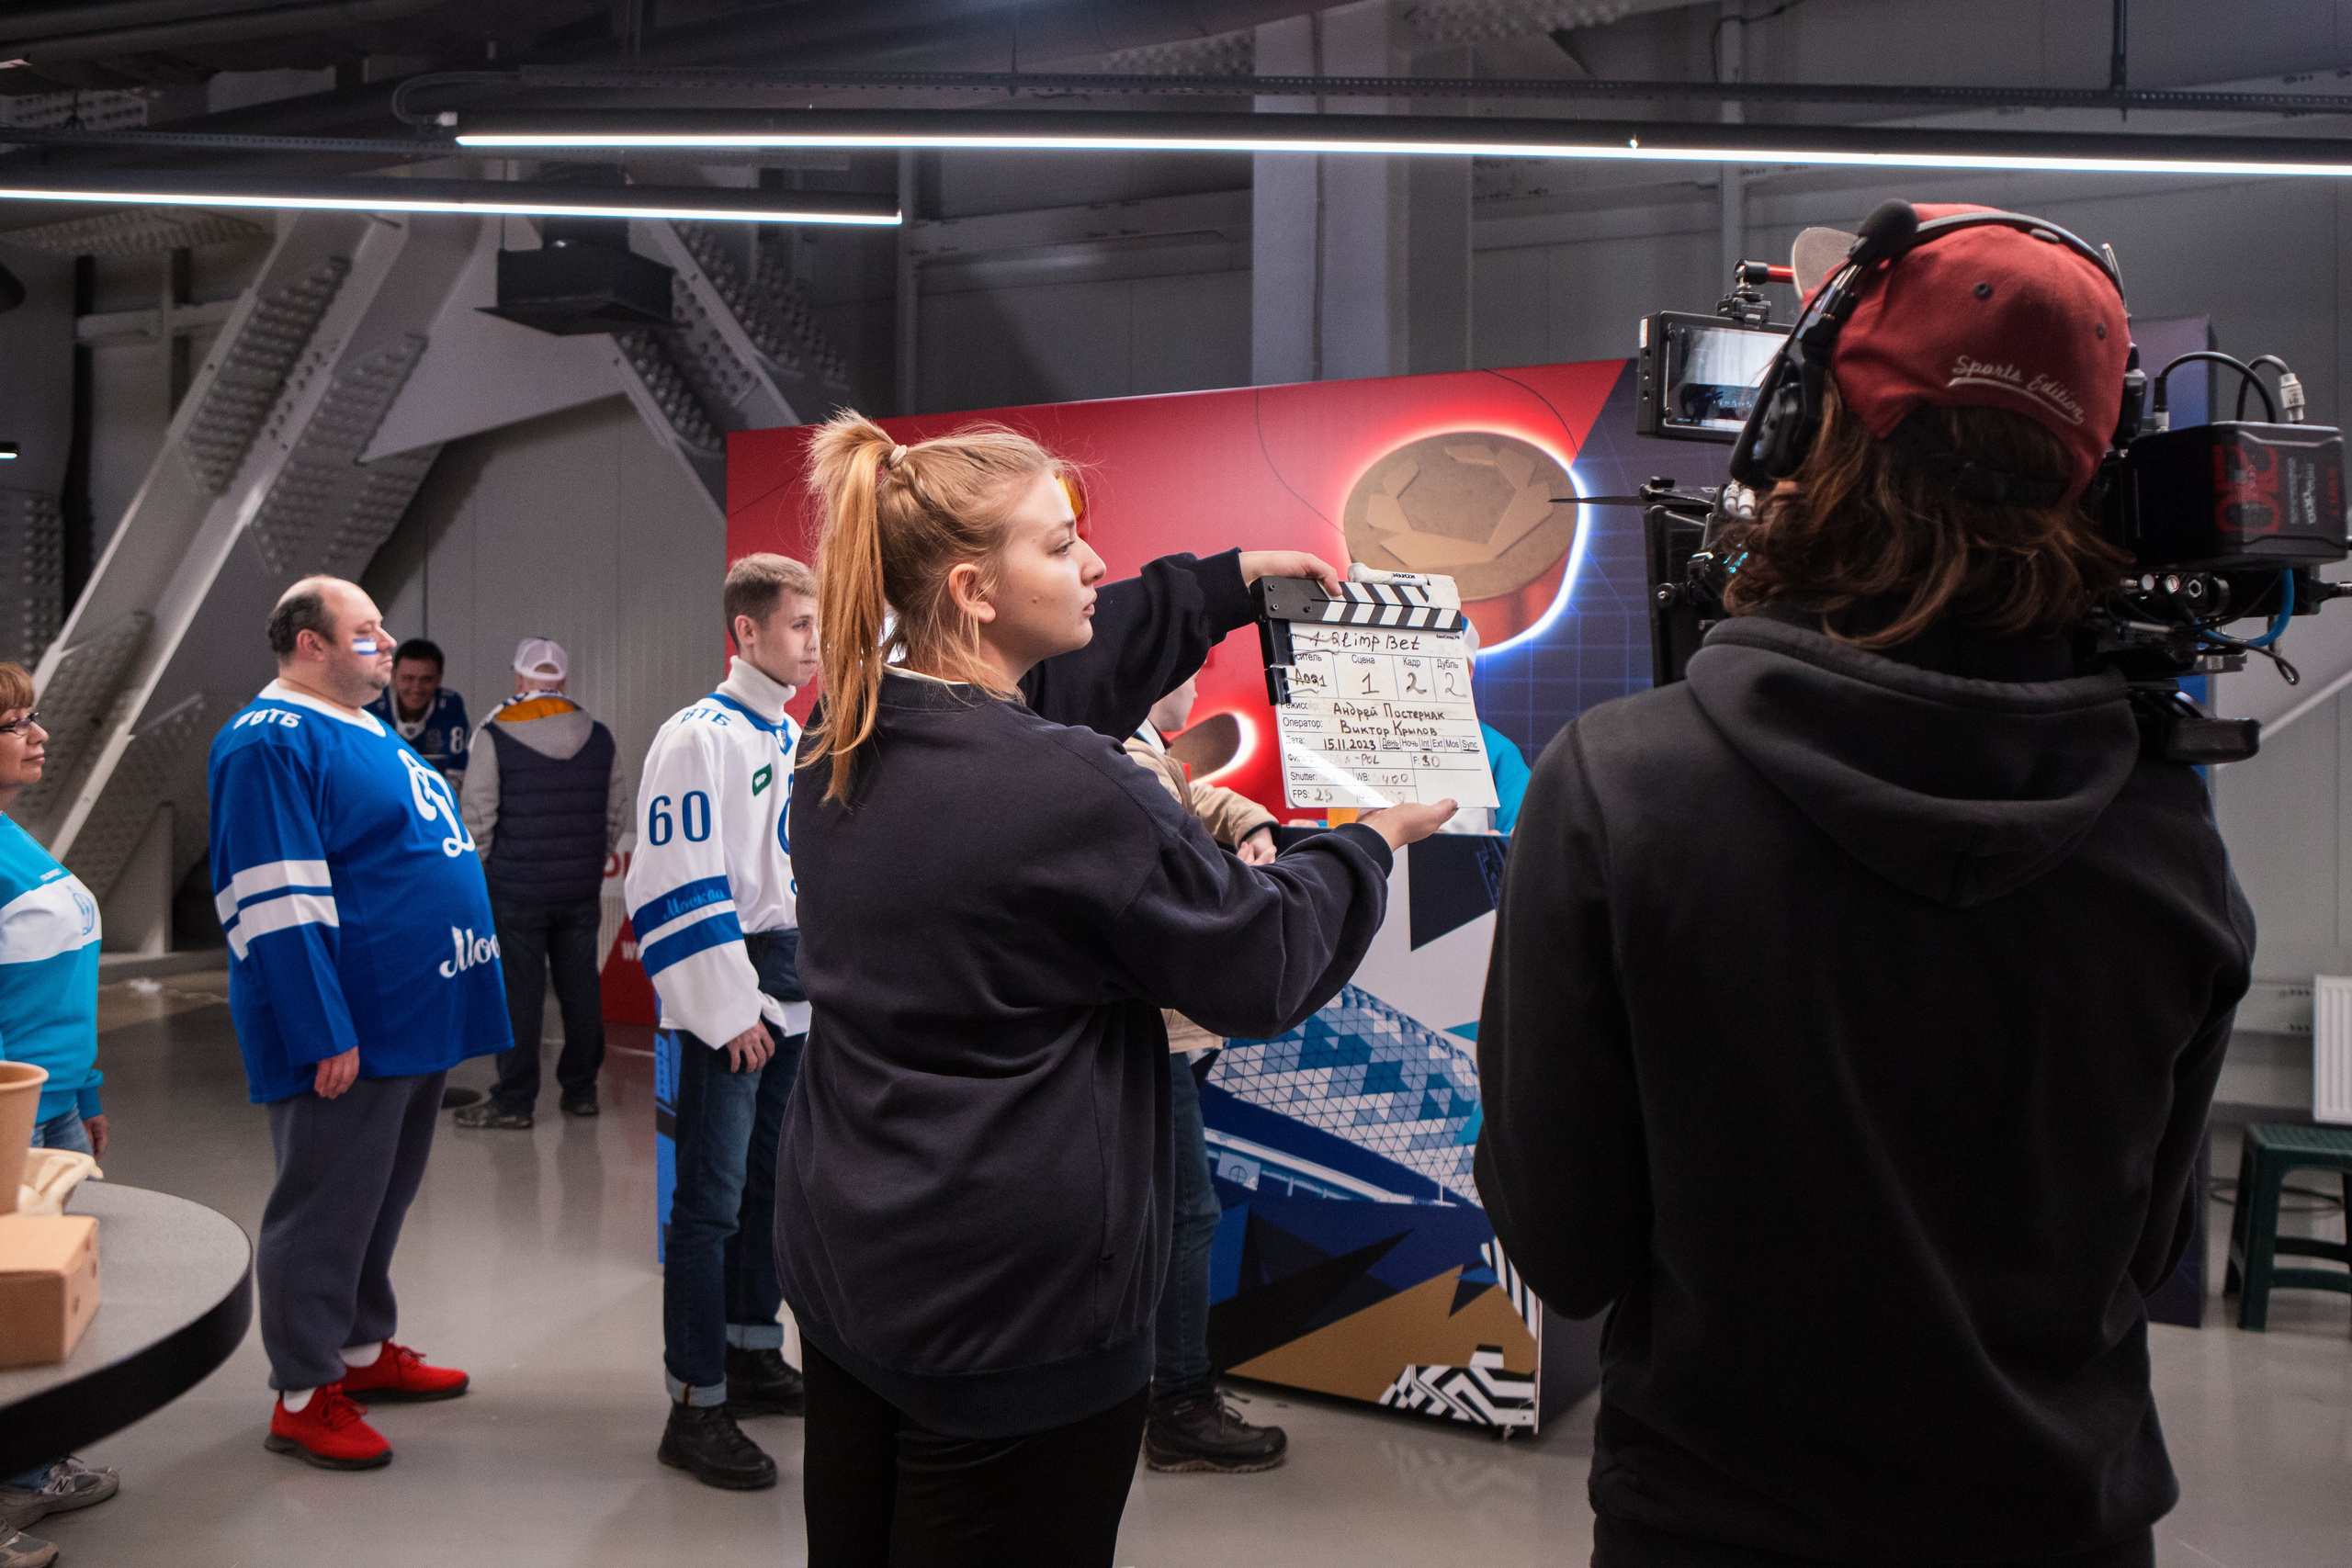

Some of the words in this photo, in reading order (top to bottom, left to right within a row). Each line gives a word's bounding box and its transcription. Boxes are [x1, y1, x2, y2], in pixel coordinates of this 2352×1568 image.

[1951, 355, 2022, 381] Sports
[2027, 372, 2085, 416] Edition
[1385, 634, 1421, 650] Bet
[1351, 654, 1376, 665] Сцена
[1402, 657, 1422, 669] Кадр
[1436, 659, 1459, 671] Дубль
[1362, 671, 1380, 695] 1
[1406, 671, 1428, 695] 2
[1444, 671, 1468, 698] 2
[681, 707, 732, 727] ВТБ
[1333, 702, 1379, 722] Андрей
[1383, 703, 1446, 722] Постернак
[1283, 716, 1324, 730] Оператор:
[1340, 718, 1390, 738] Виктор
[1392, 719, 1439, 738] Крылов
[1323, 738, 1377, 751] 15.11.2023
[1382, 738, 1399, 749] День
[1402, 738, 1419, 749] Ночь
[1420, 739, 1430, 748] Int
[1432, 739, 1443, 749] Ext
[1445, 739, 1460, 749] Mos
[1462, 739, 1478, 750] Sync
[1413, 756, 1420, 765] F:
[1290, 772, 1317, 782] Shutter:
[1355, 773, 1371, 782] WB:
[1292, 789, 1310, 799] FPS:
[1314, 788, 1333, 803] 25
[649, 790, 711, 846] 60
[663, 888, 727, 919] Москва
